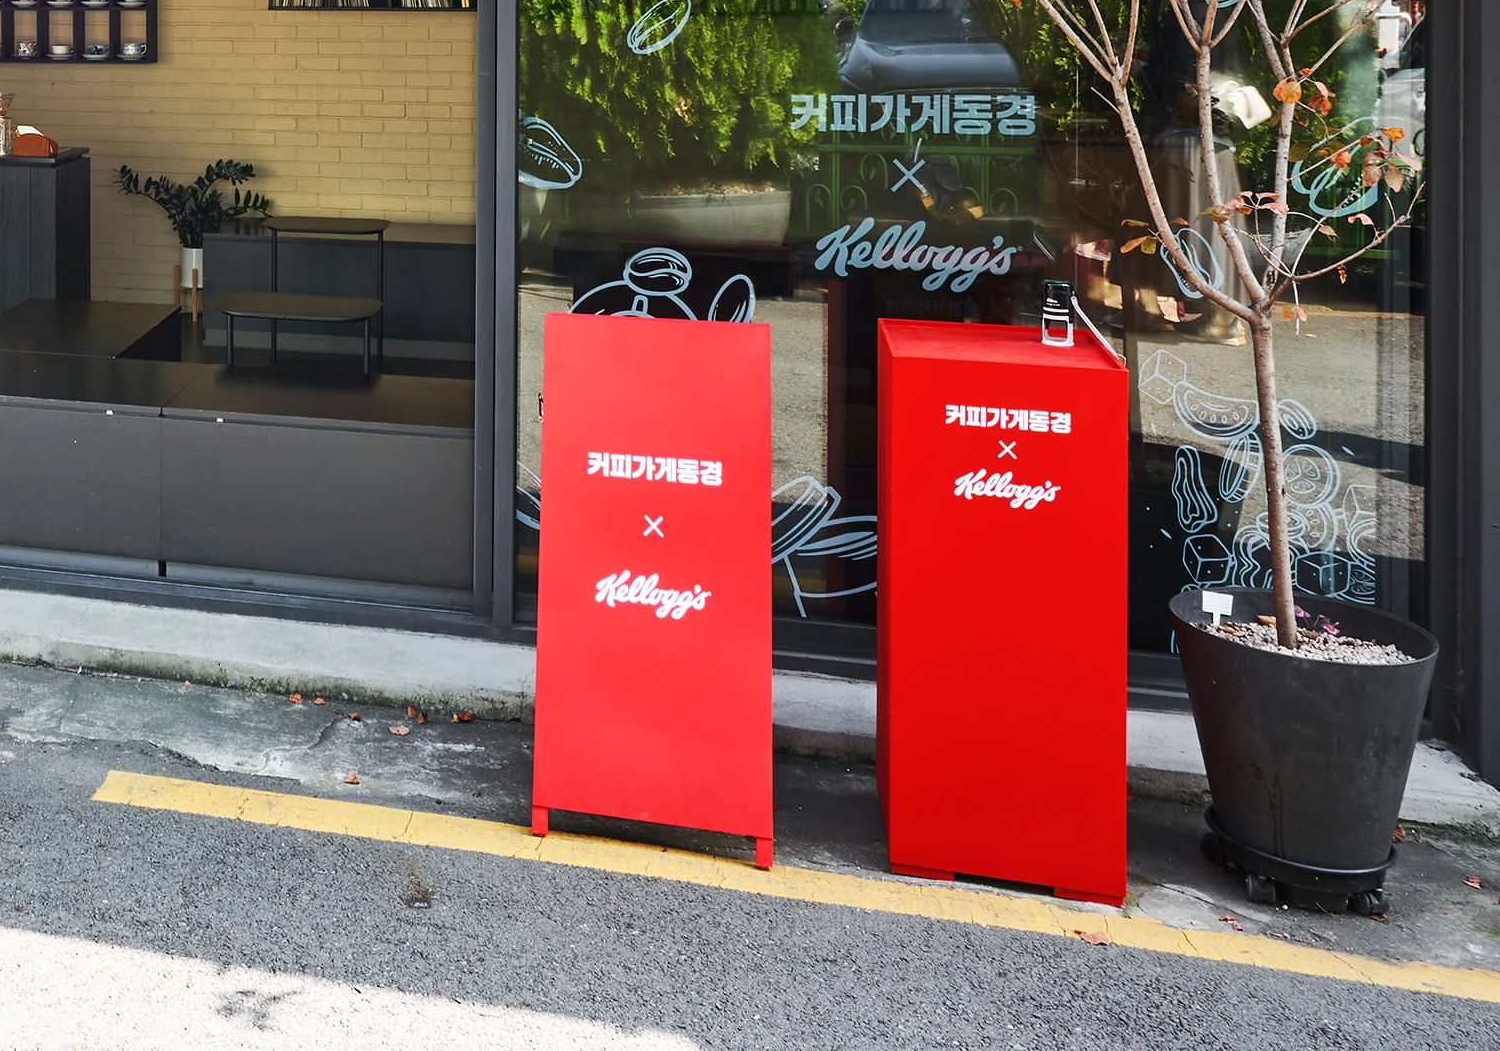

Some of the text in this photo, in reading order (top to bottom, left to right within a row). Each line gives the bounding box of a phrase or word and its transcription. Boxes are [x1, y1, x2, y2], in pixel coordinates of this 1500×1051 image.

[790, 92, 1036, 136] 커피가게동경
[814, 216, 1020, 293] Kellogg's
[945, 404, 1072, 434] 커피가게동경
[587, 451, 723, 486] 커피가게동경
[953, 468, 1061, 510] Kellogg's
[595, 569, 711, 620] Kellogg's
